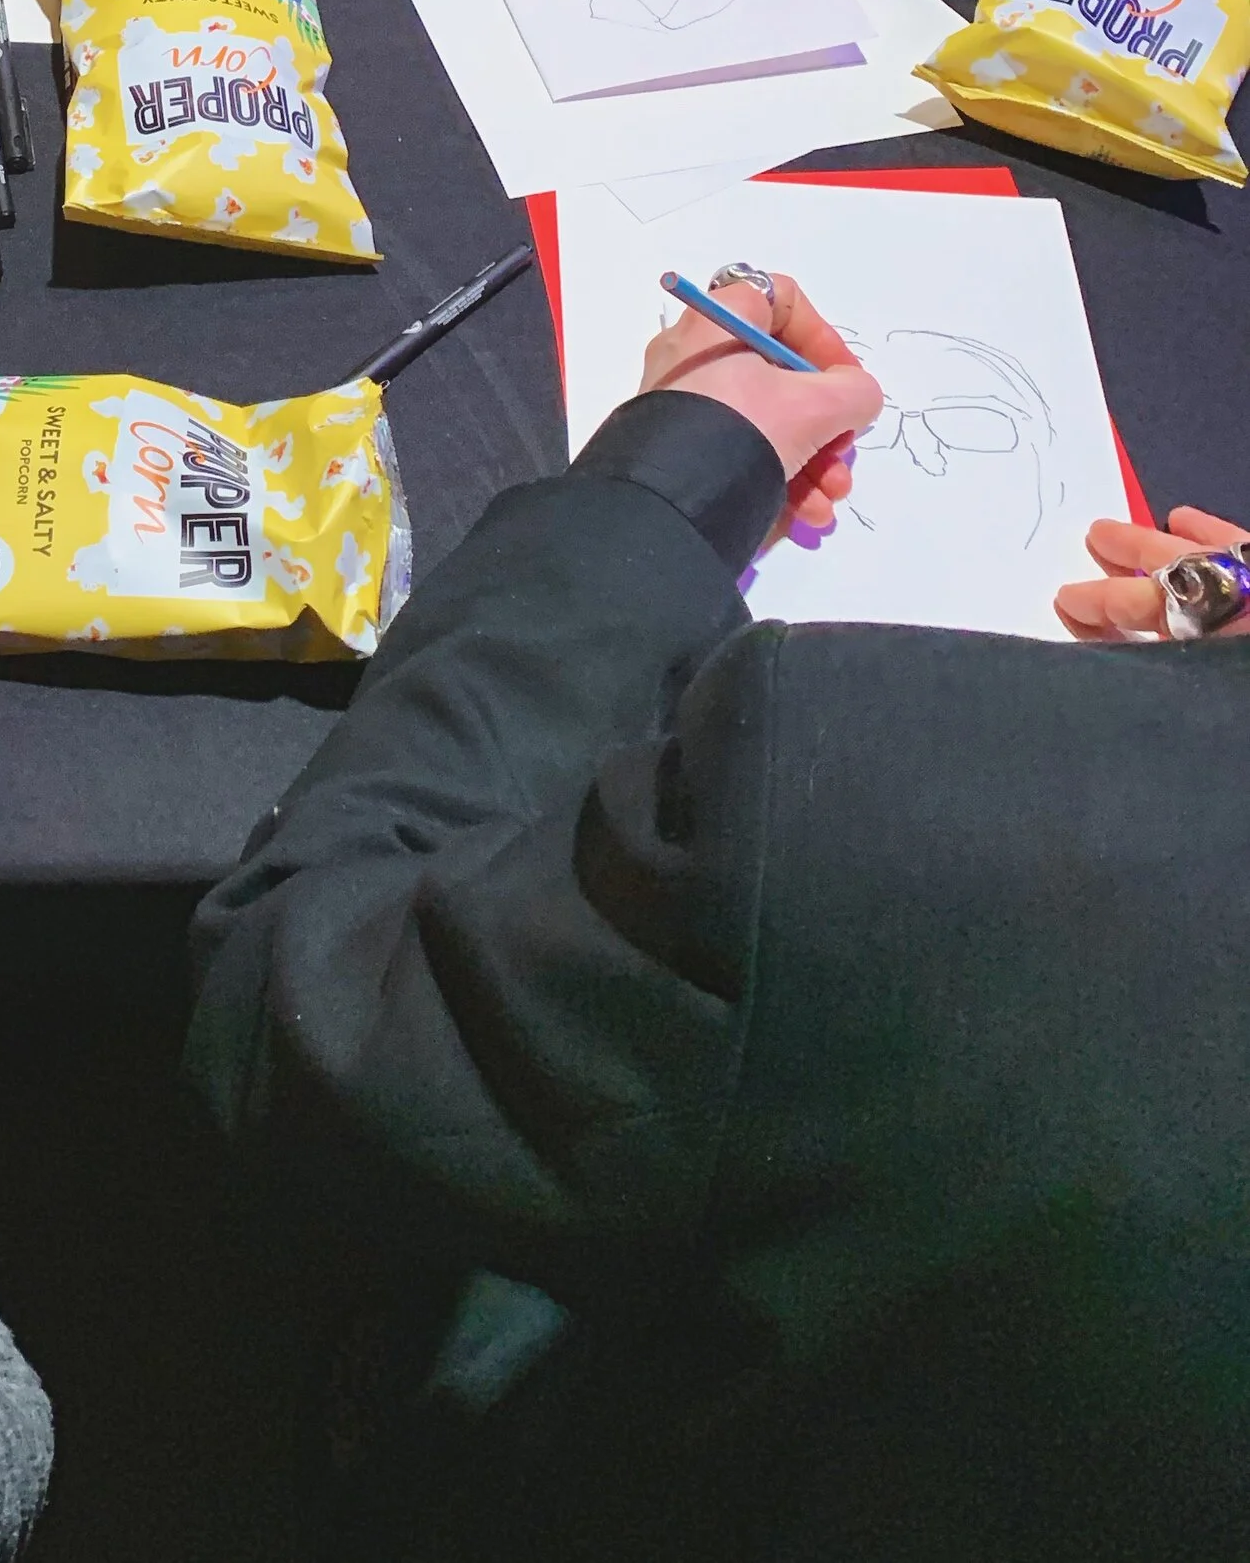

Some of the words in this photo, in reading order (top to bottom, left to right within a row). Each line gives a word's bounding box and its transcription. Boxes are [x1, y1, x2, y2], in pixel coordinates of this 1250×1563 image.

[162, 46, 278, 93] Corn
[129, 76, 314, 149] PROPER
[37, 406, 66, 465] SWEET
[16, 439, 32, 505] POPCORN
[38, 469, 57, 485] &
[130, 421, 206, 544] Corn
[179, 418, 252, 589] PROPER
[33, 489, 56, 557] SALTY
